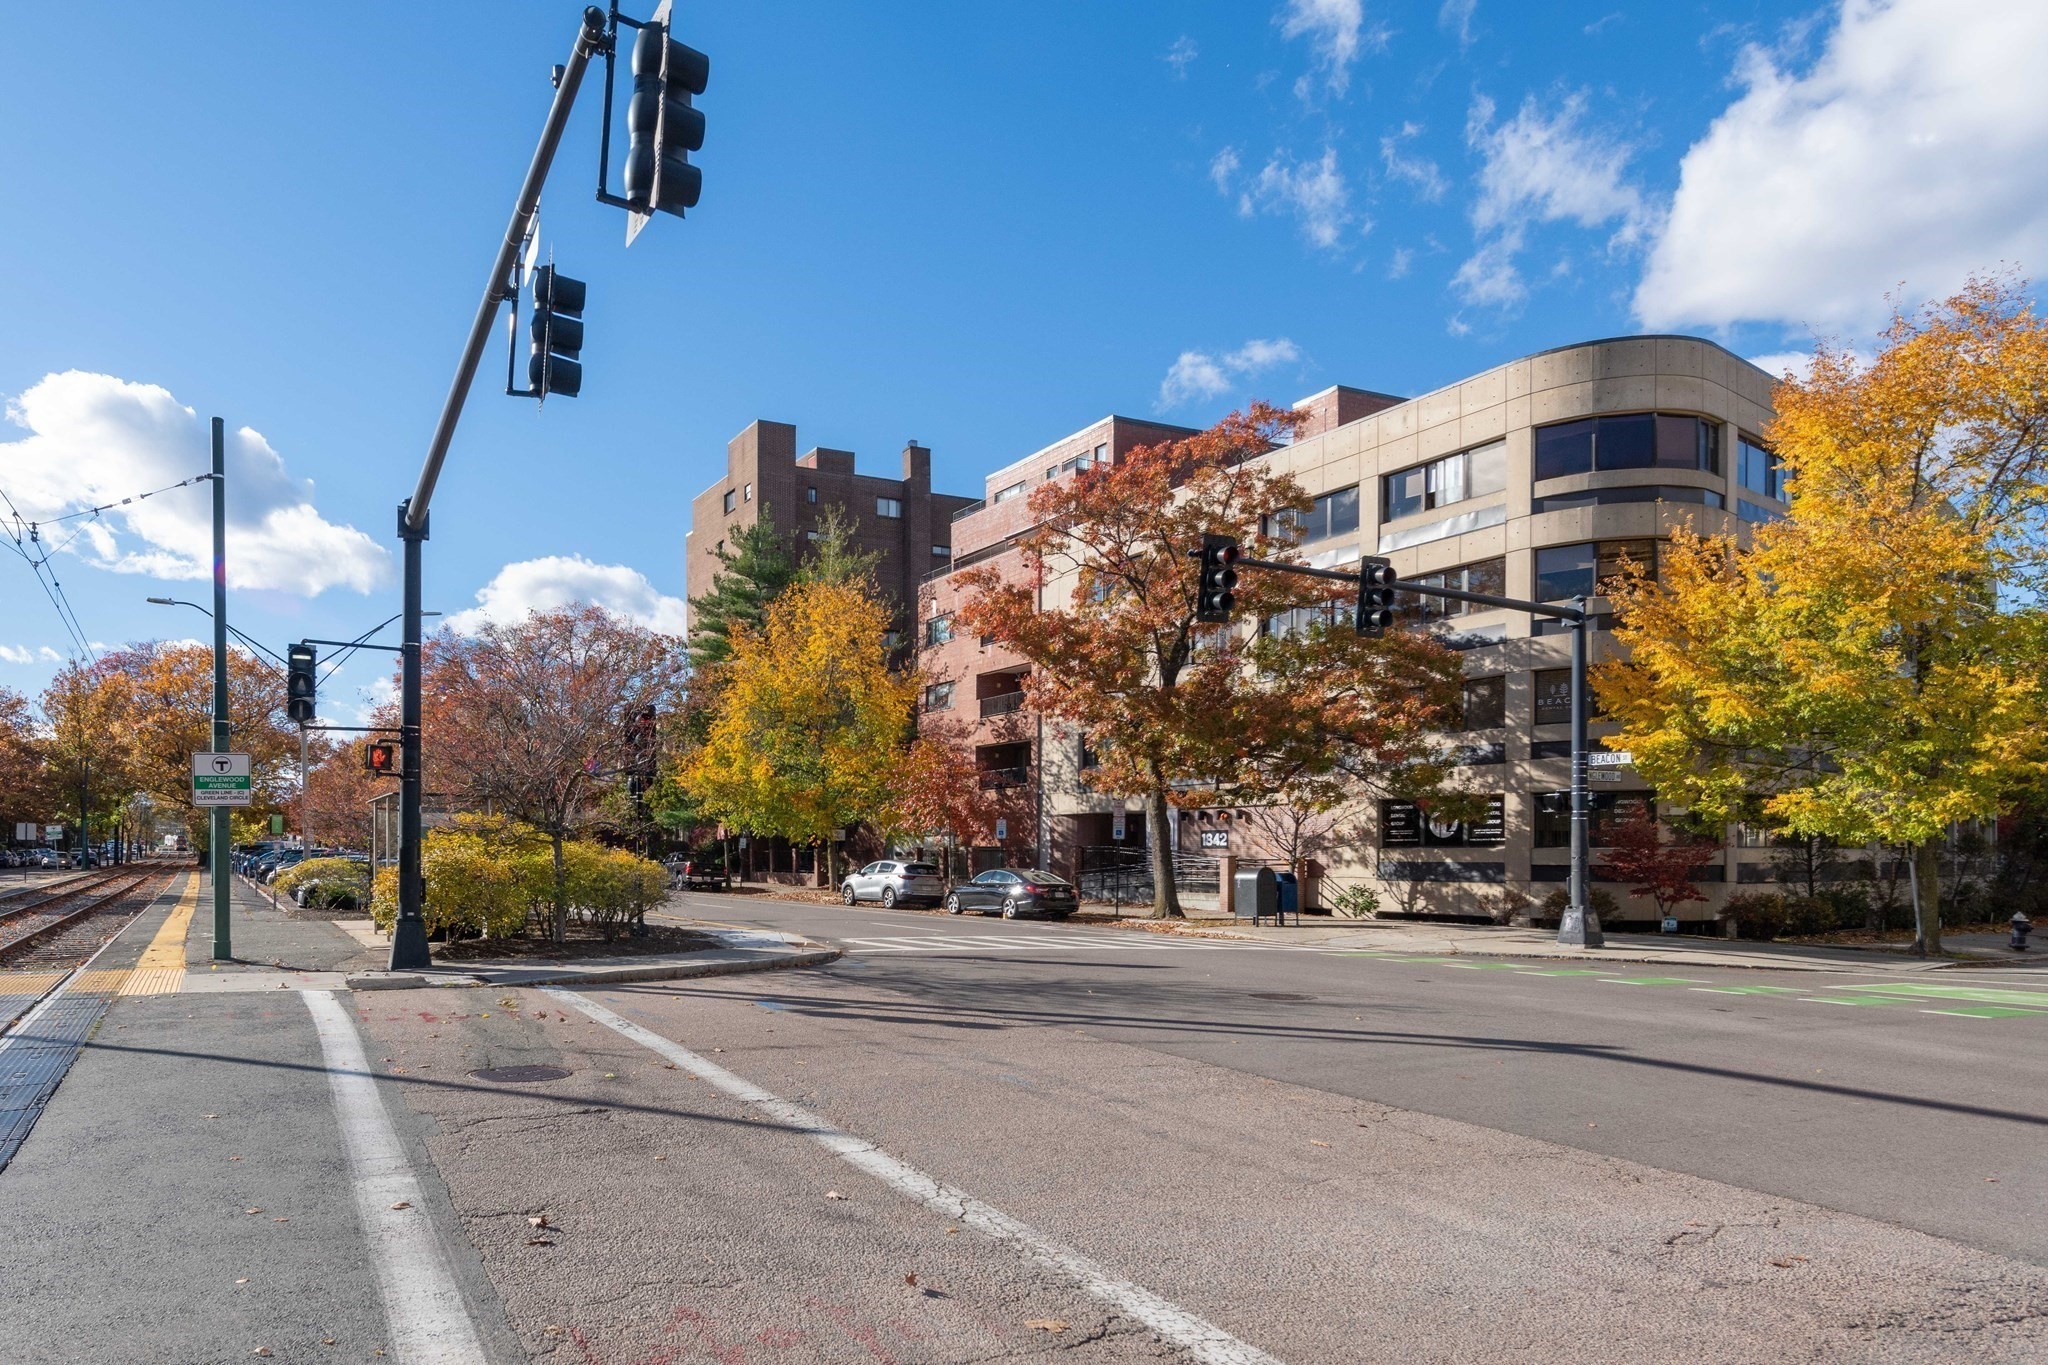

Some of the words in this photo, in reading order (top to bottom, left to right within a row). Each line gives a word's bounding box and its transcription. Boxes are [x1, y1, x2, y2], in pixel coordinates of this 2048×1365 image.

[1591, 753, 1621, 764] BEACON
[215, 761, 228, 771] T
[1587, 771, 1615, 781] NGLEWOOD
[1201, 832, 1228, 847] 1842
